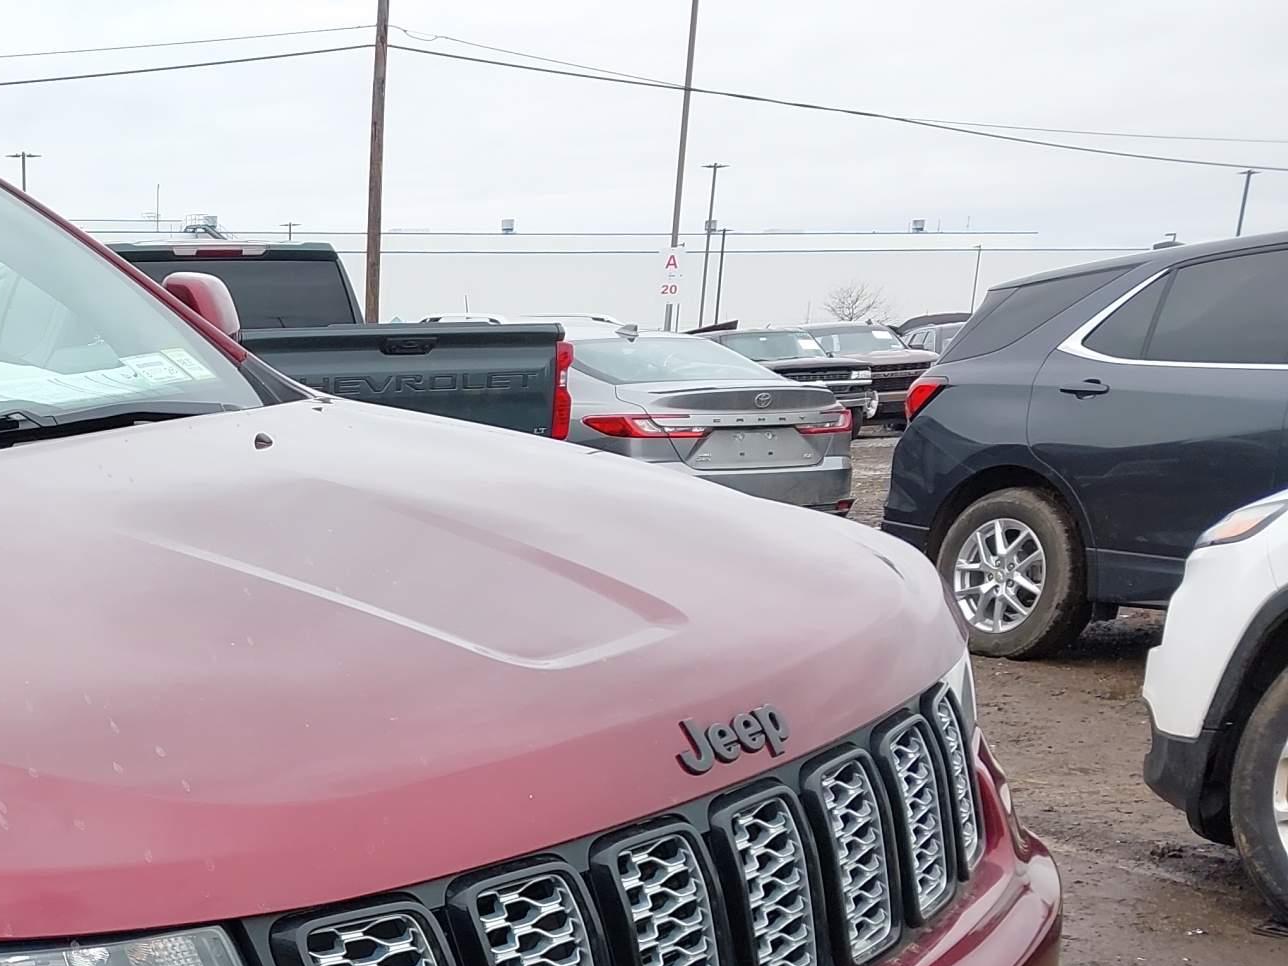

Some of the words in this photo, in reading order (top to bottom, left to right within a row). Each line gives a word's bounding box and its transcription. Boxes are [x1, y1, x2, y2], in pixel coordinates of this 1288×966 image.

[665, 254, 678, 269] A
[661, 284, 678, 295] 20
[300, 371, 538, 396] HEVROLET
[675, 703, 790, 776] Jeep
